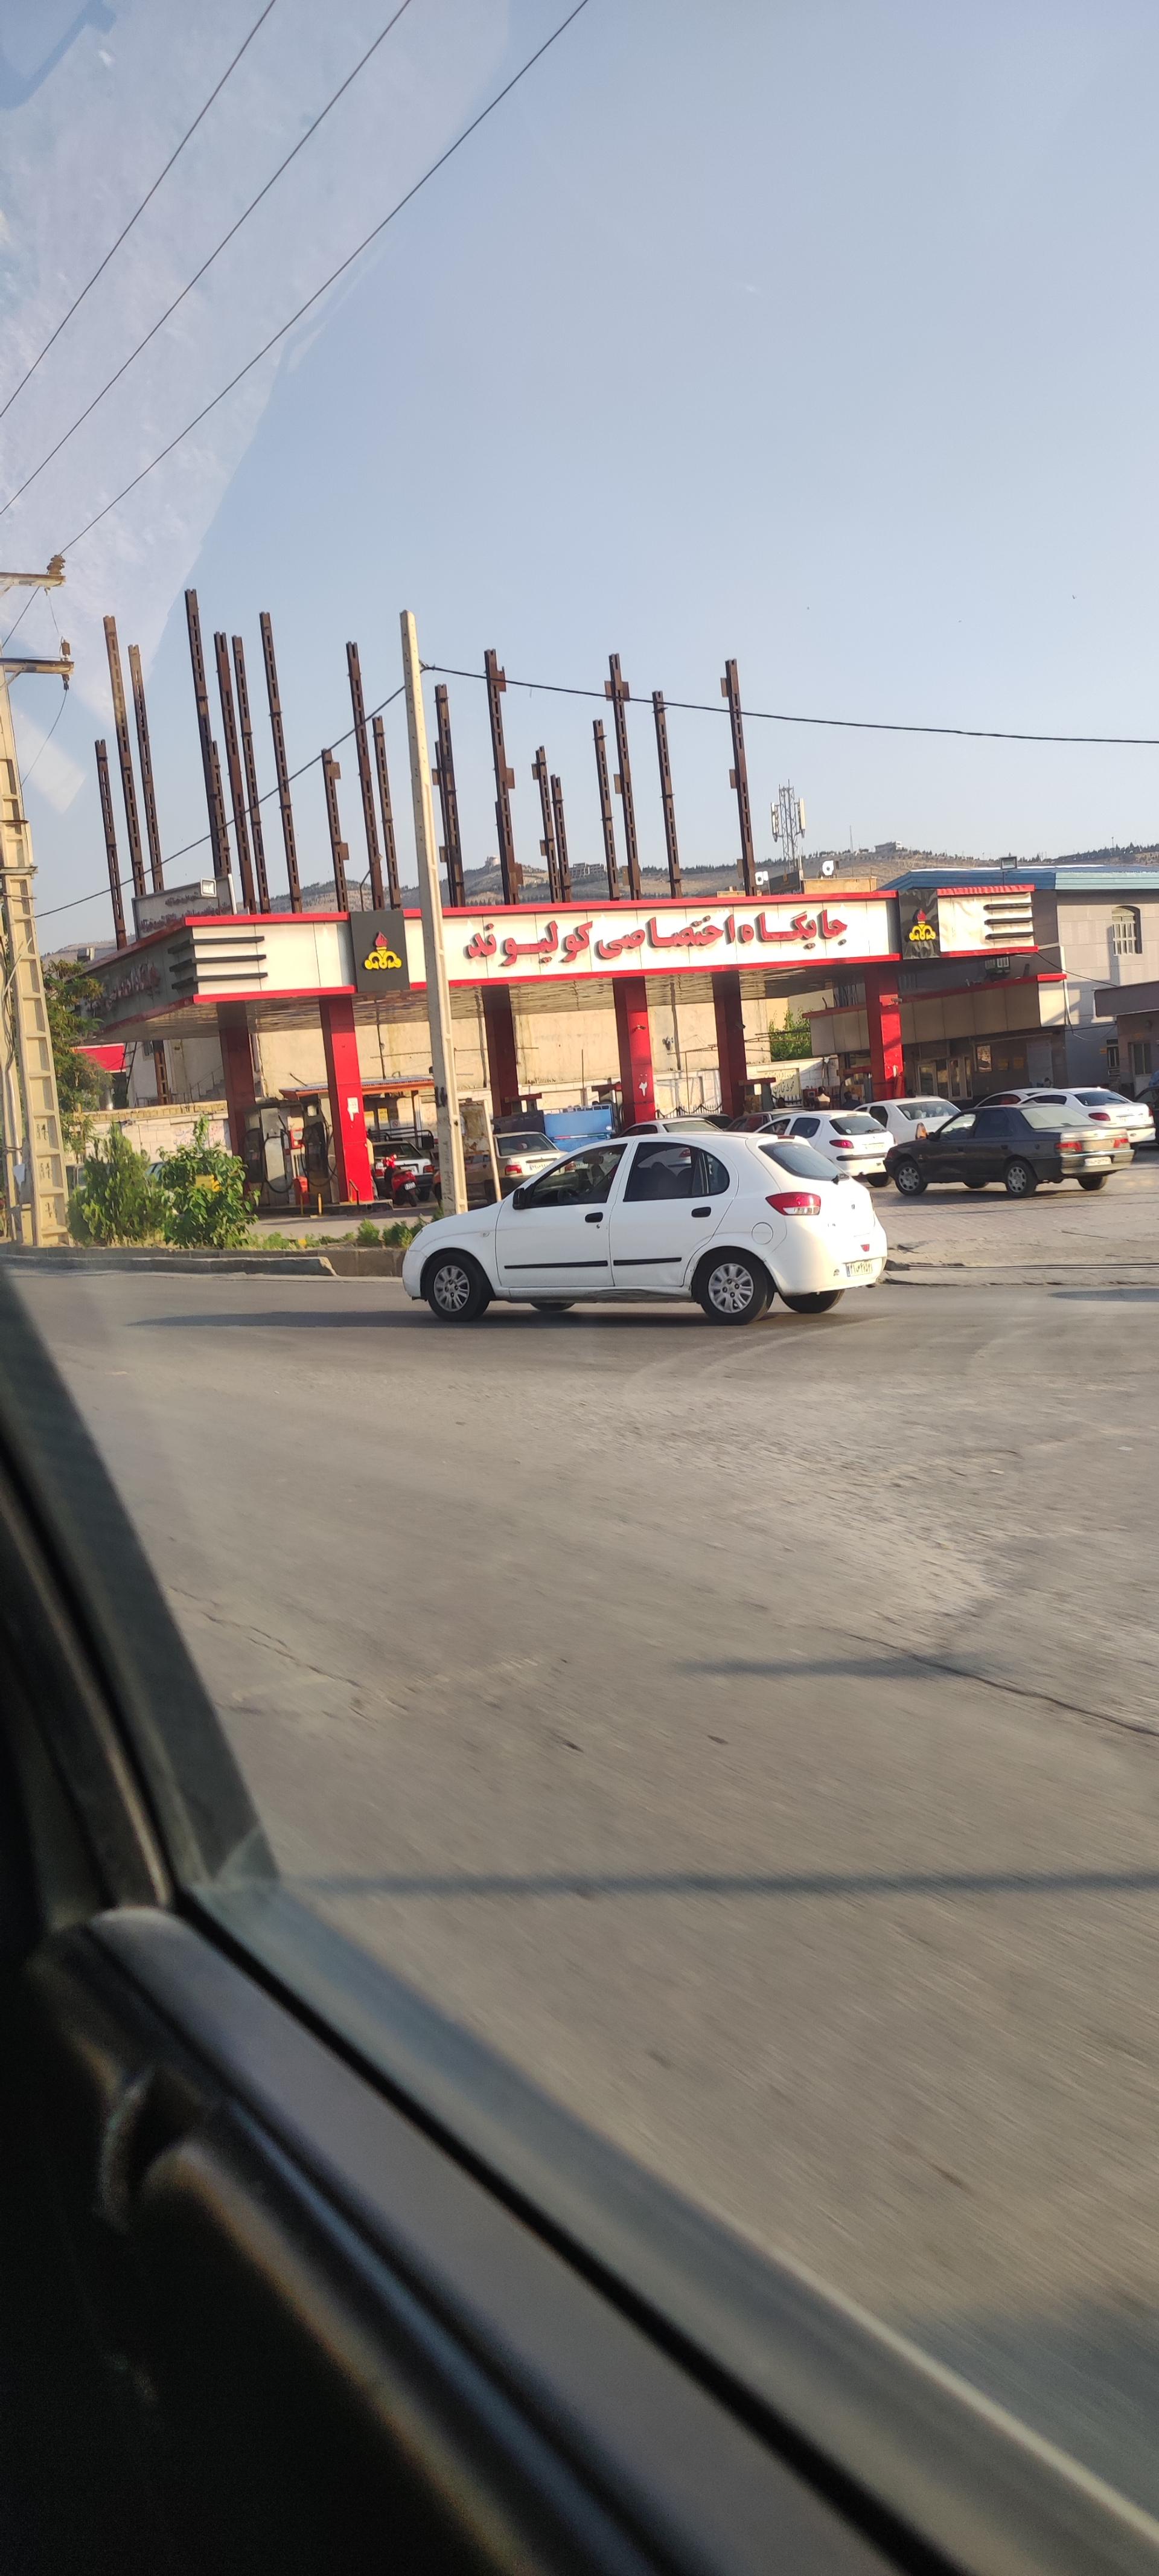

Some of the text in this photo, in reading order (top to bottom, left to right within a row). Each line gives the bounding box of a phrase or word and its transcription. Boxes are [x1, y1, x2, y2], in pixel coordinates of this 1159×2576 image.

[464, 909, 848, 967] جایگاه اختصاصی کولیوند
